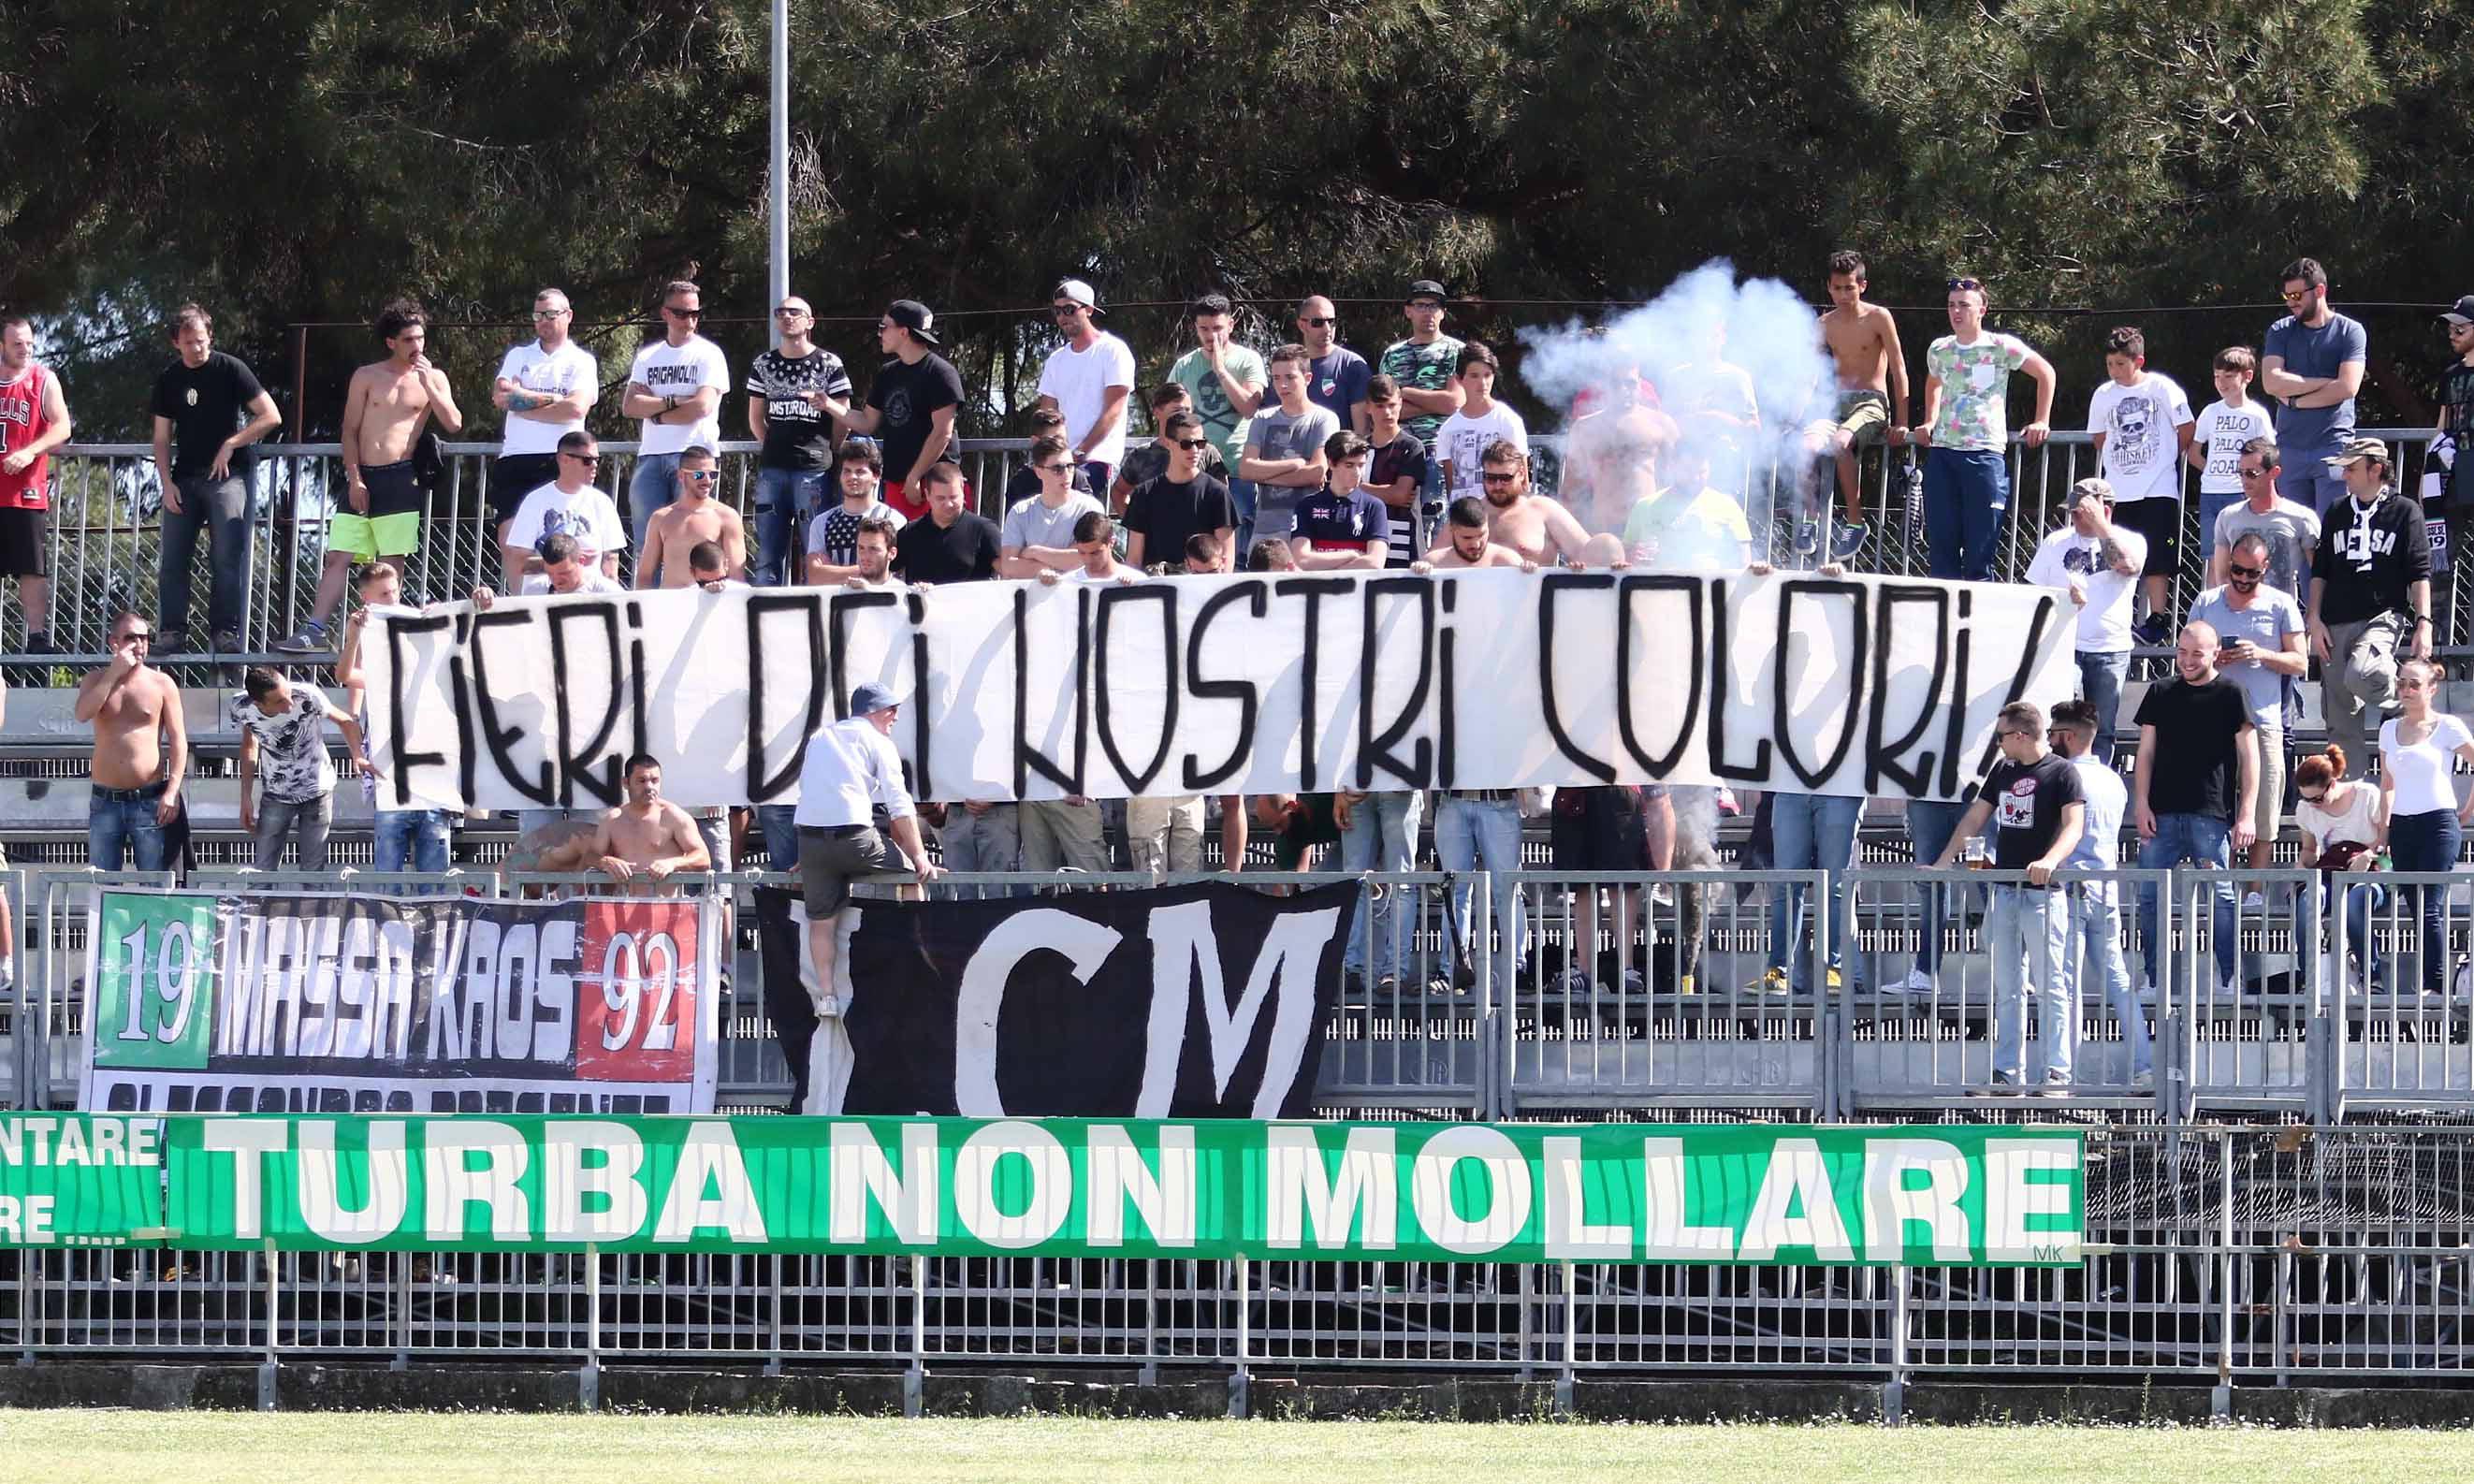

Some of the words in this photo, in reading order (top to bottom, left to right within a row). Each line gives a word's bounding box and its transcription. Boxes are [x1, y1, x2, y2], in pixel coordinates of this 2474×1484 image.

[2215, 415, 2250, 431] PALO
[2214, 437, 2245, 452] PALO
[118, 921, 193, 1044] 19
[217, 915, 415, 1060] MASSA
[427, 920, 576, 1061] KAOS
[601, 930, 678, 1053] 92
[0, 1117, 159, 1166] NTARE
[204, 1119, 769, 1244] TURBA
[830, 1121, 1197, 1249] NON
[1267, 1125, 2082, 1262] MOLLARE
[2033, 1244, 2064, 1262] MK
